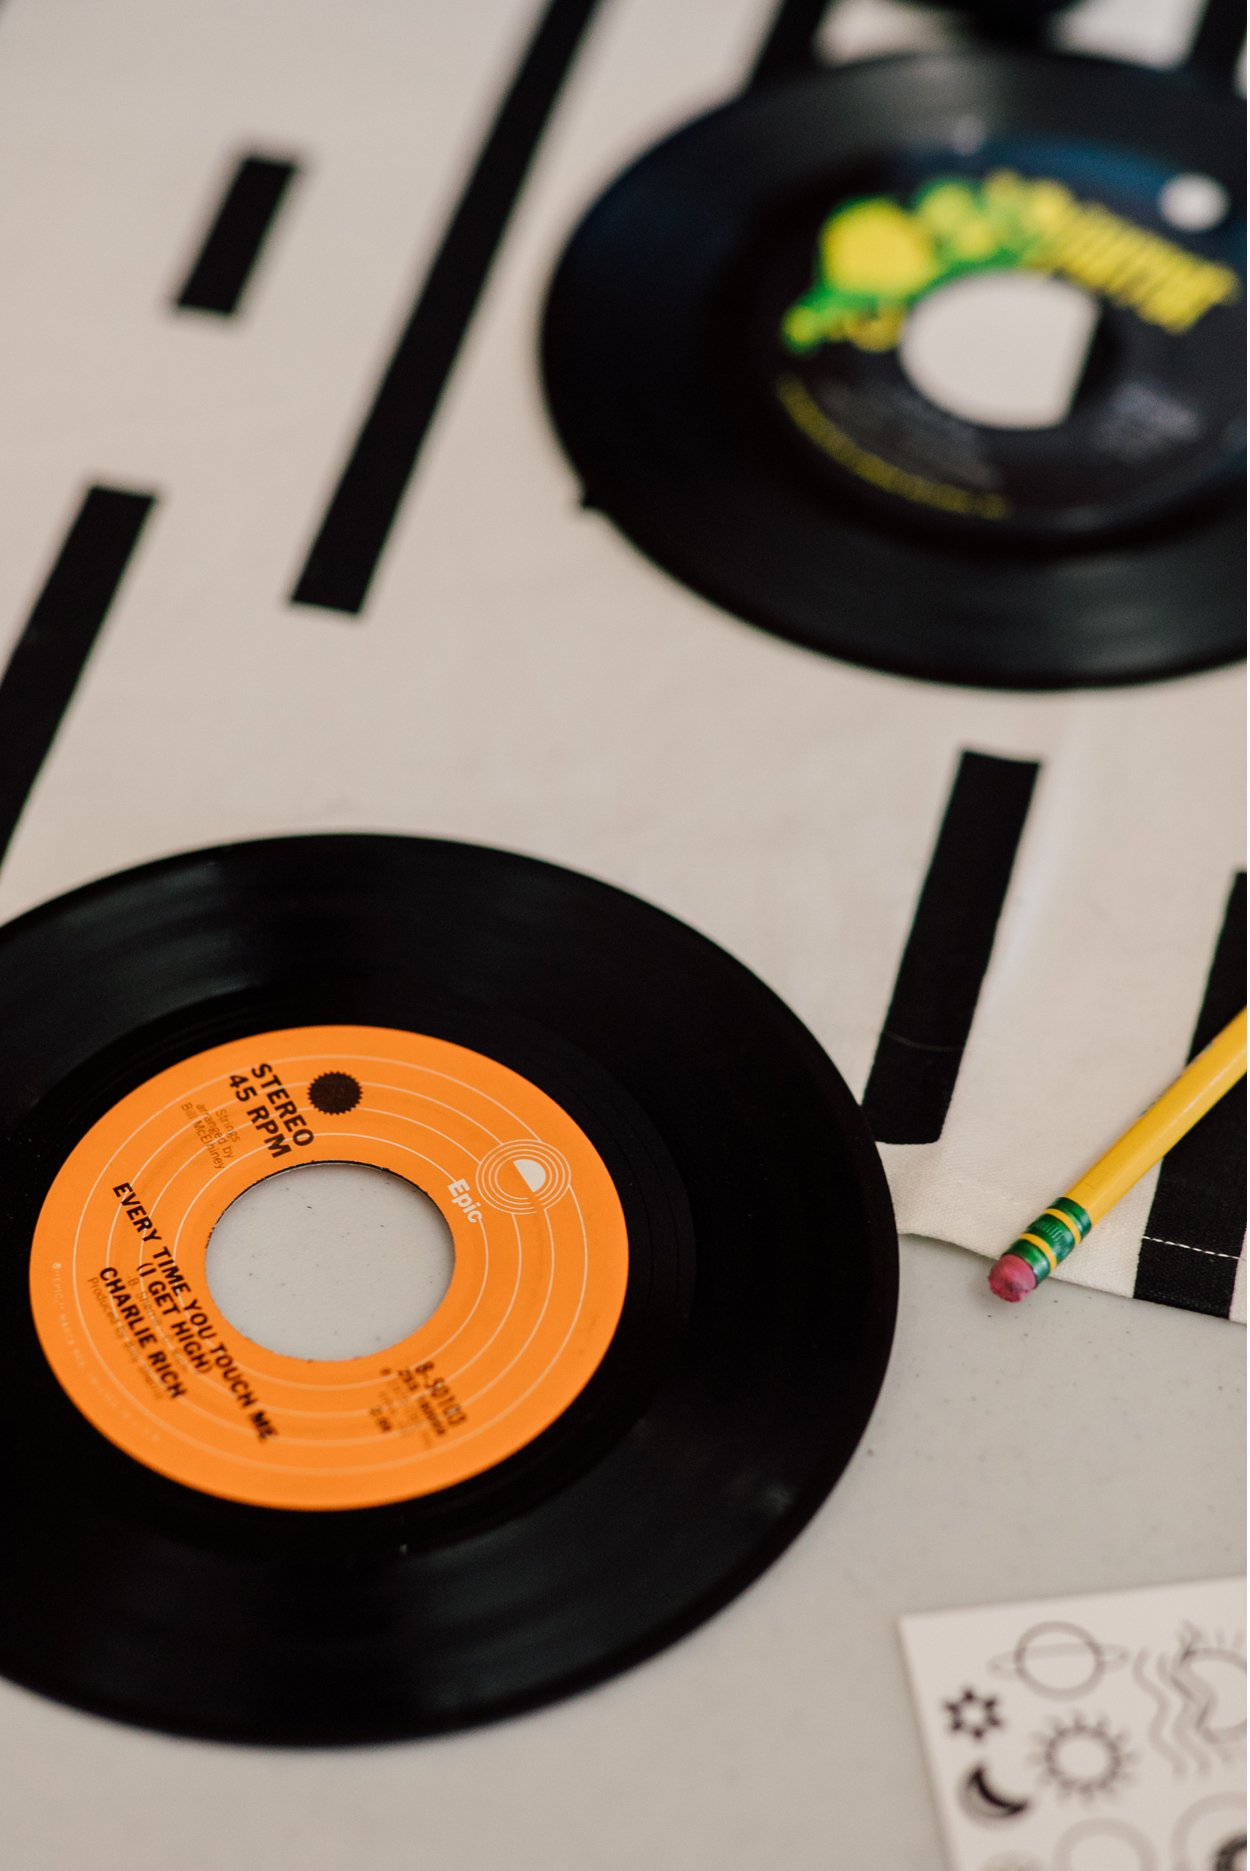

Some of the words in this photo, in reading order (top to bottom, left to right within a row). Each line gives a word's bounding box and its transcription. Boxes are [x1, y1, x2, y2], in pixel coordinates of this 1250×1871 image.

[181, 1102, 197, 1120] Bill
[196, 1103, 228, 1146] arranged
[222, 1146, 235, 1158] by
[216, 1108, 241, 1143] Strings
[229, 1074, 258, 1102] 45
[246, 1105, 292, 1158] RPM
[251, 1063, 314, 1147] STEREO
[447, 1178, 483, 1223] Epic
[100, 1267, 157, 1348] CHARLIE
[147, 1350, 188, 1400] RICH
[112, 1182, 162, 1243] EVERY
[152, 1246, 191, 1296] TIME
[183, 1298, 217, 1340] YOU
[210, 1342, 257, 1407] TOUCH
[249, 1411, 279, 1442] ME
[136, 1262, 157, 1278] (I
[147, 1280, 181, 1316] GET
[170, 1320, 214, 1375] HIGH)
